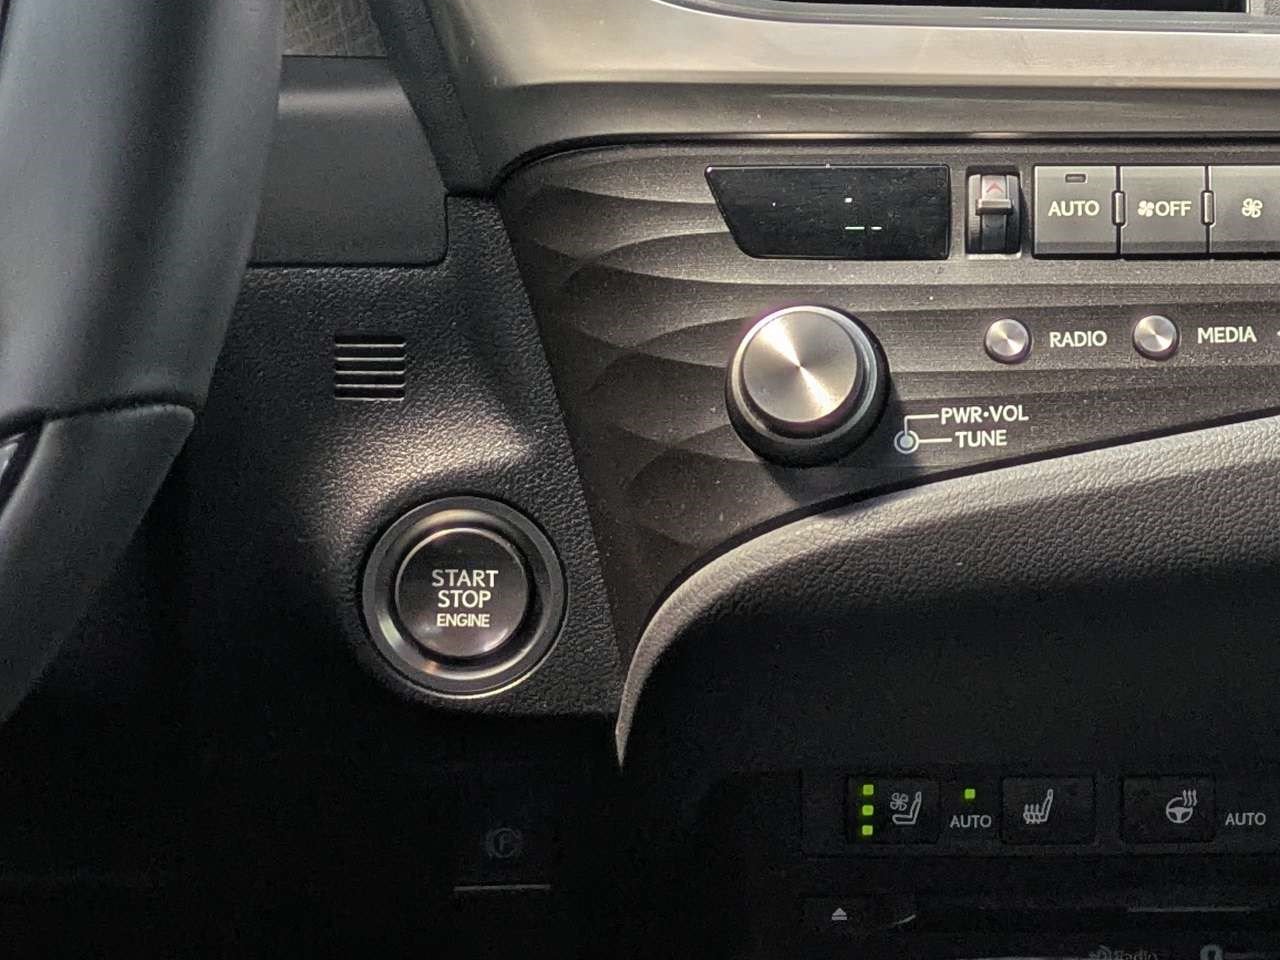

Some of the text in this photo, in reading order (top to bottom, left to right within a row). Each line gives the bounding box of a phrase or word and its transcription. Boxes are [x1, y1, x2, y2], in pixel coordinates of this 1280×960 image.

[1048, 201, 1100, 217] AUTO
[1155, 201, 1192, 217] OFF
[1049, 330, 1108, 348] RADIO
[1198, 326, 1257, 344] MEDIA
[955, 429, 1008, 449] TUNE
[431, 569, 499, 588] START
[437, 590, 492, 609] STOP
[436, 613, 491, 628] ENGINE
[949, 814, 993, 830] AUTO
[1225, 811, 1267, 827] AUTO
